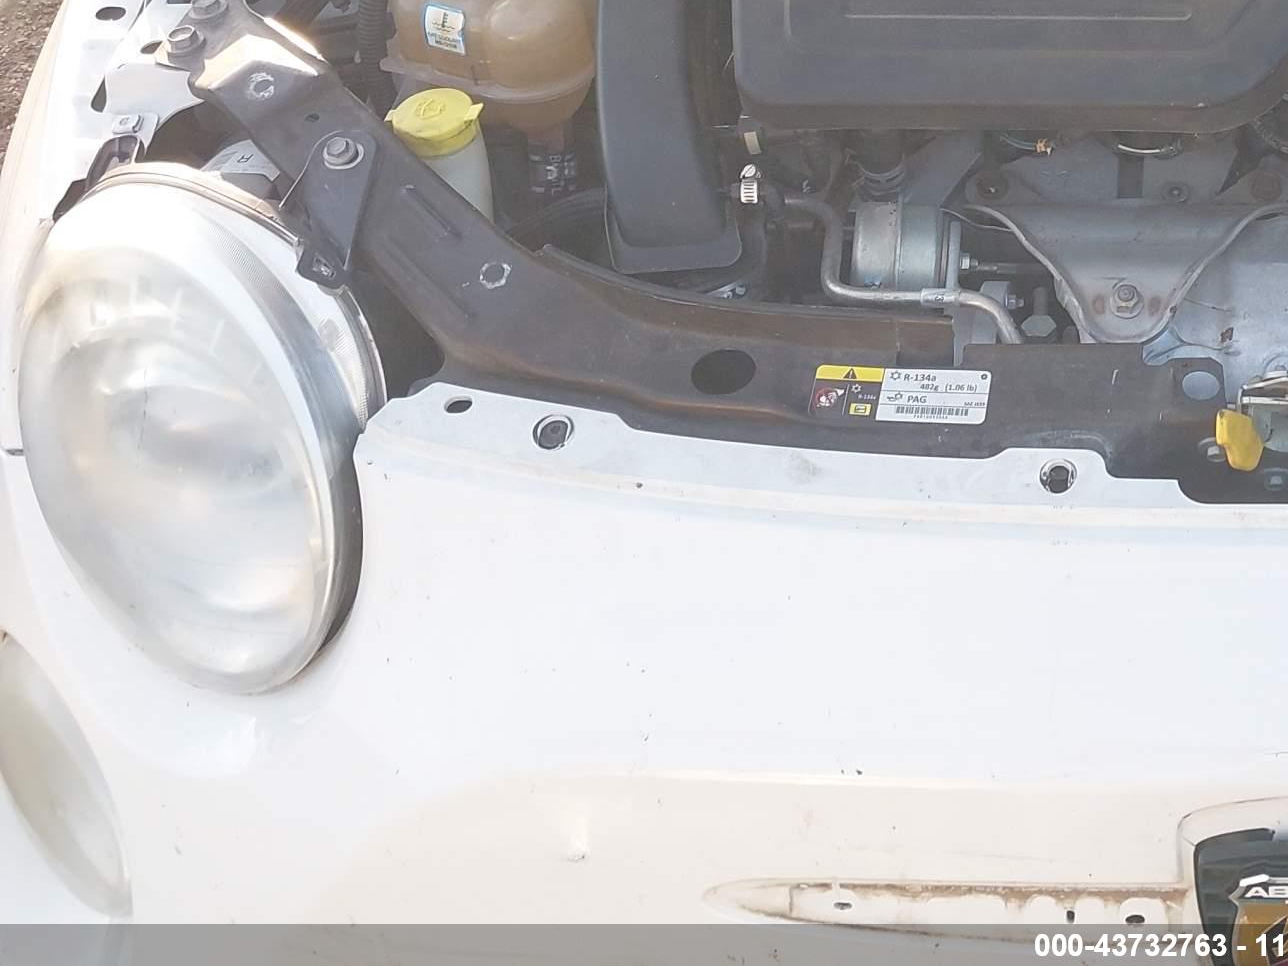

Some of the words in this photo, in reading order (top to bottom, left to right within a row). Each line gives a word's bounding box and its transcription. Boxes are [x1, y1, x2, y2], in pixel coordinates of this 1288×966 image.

[903, 373, 937, 382] R-134a
[945, 383, 965, 393] (1.06
[966, 383, 978, 393] lb)
[907, 395, 928, 404] PAG
